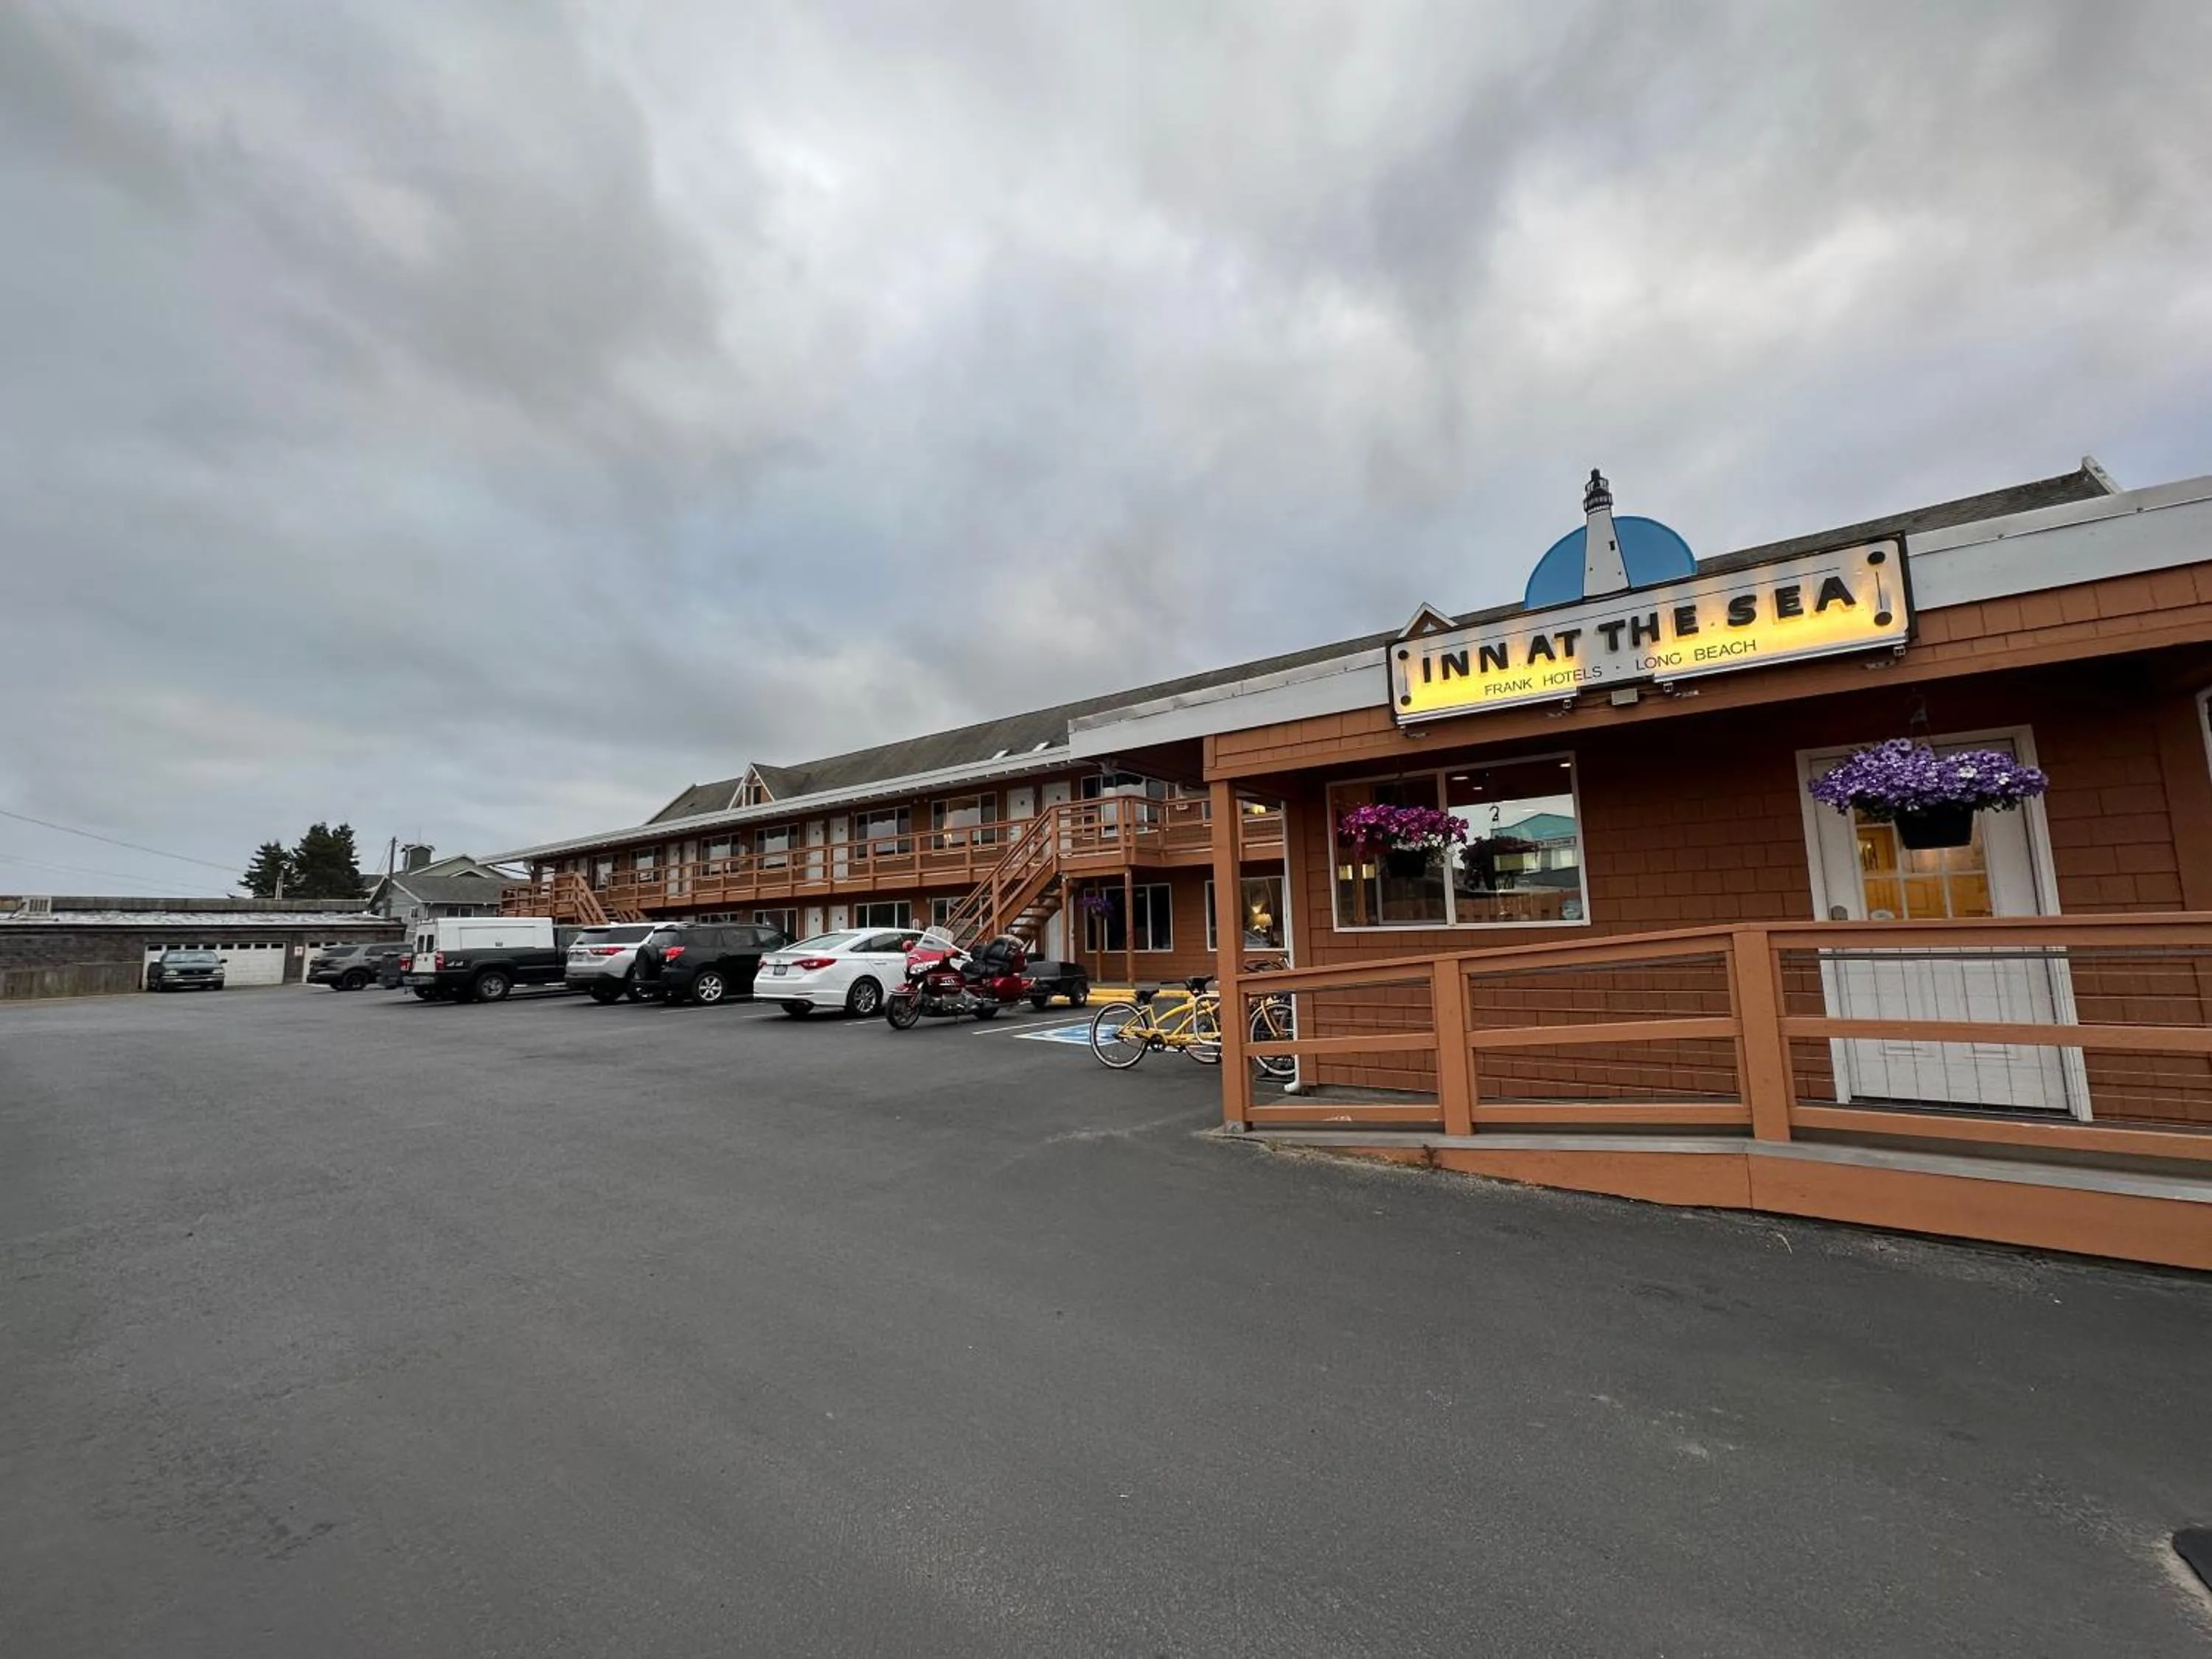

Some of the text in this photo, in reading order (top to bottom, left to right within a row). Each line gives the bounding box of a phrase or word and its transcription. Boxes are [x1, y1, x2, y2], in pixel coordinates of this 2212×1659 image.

[1422, 576, 1856, 684] INN AT THE SEA
[1484, 639, 1757, 696] FRANK HOTELS LONG BEACH
